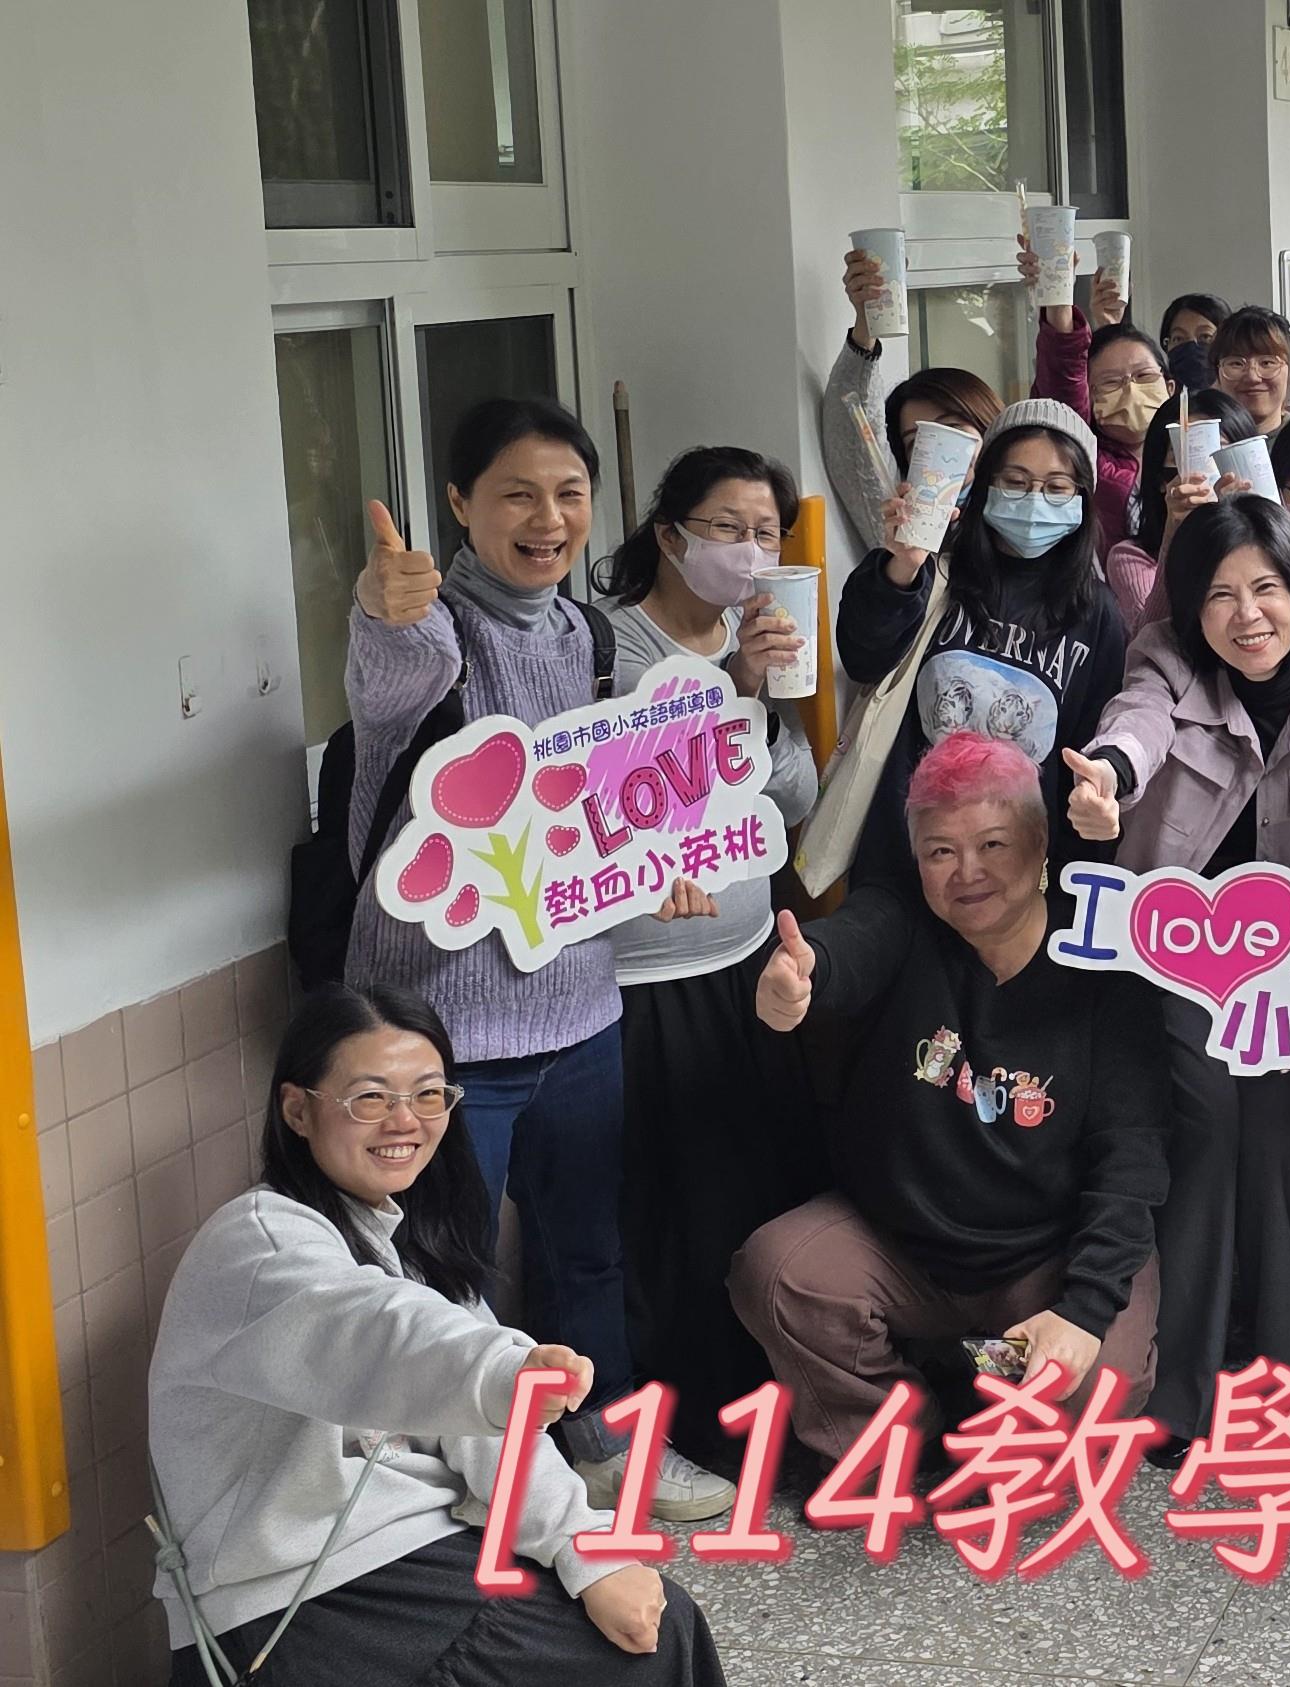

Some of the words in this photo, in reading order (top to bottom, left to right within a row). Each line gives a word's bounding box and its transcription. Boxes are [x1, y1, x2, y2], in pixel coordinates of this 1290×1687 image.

[533, 686, 724, 762] 桃園市國小英語輔導團
[581, 718, 755, 859] LOVE
[544, 814, 768, 929] 熱血小英桃
[1058, 873, 1126, 960] I
[1149, 909, 1280, 957] love
